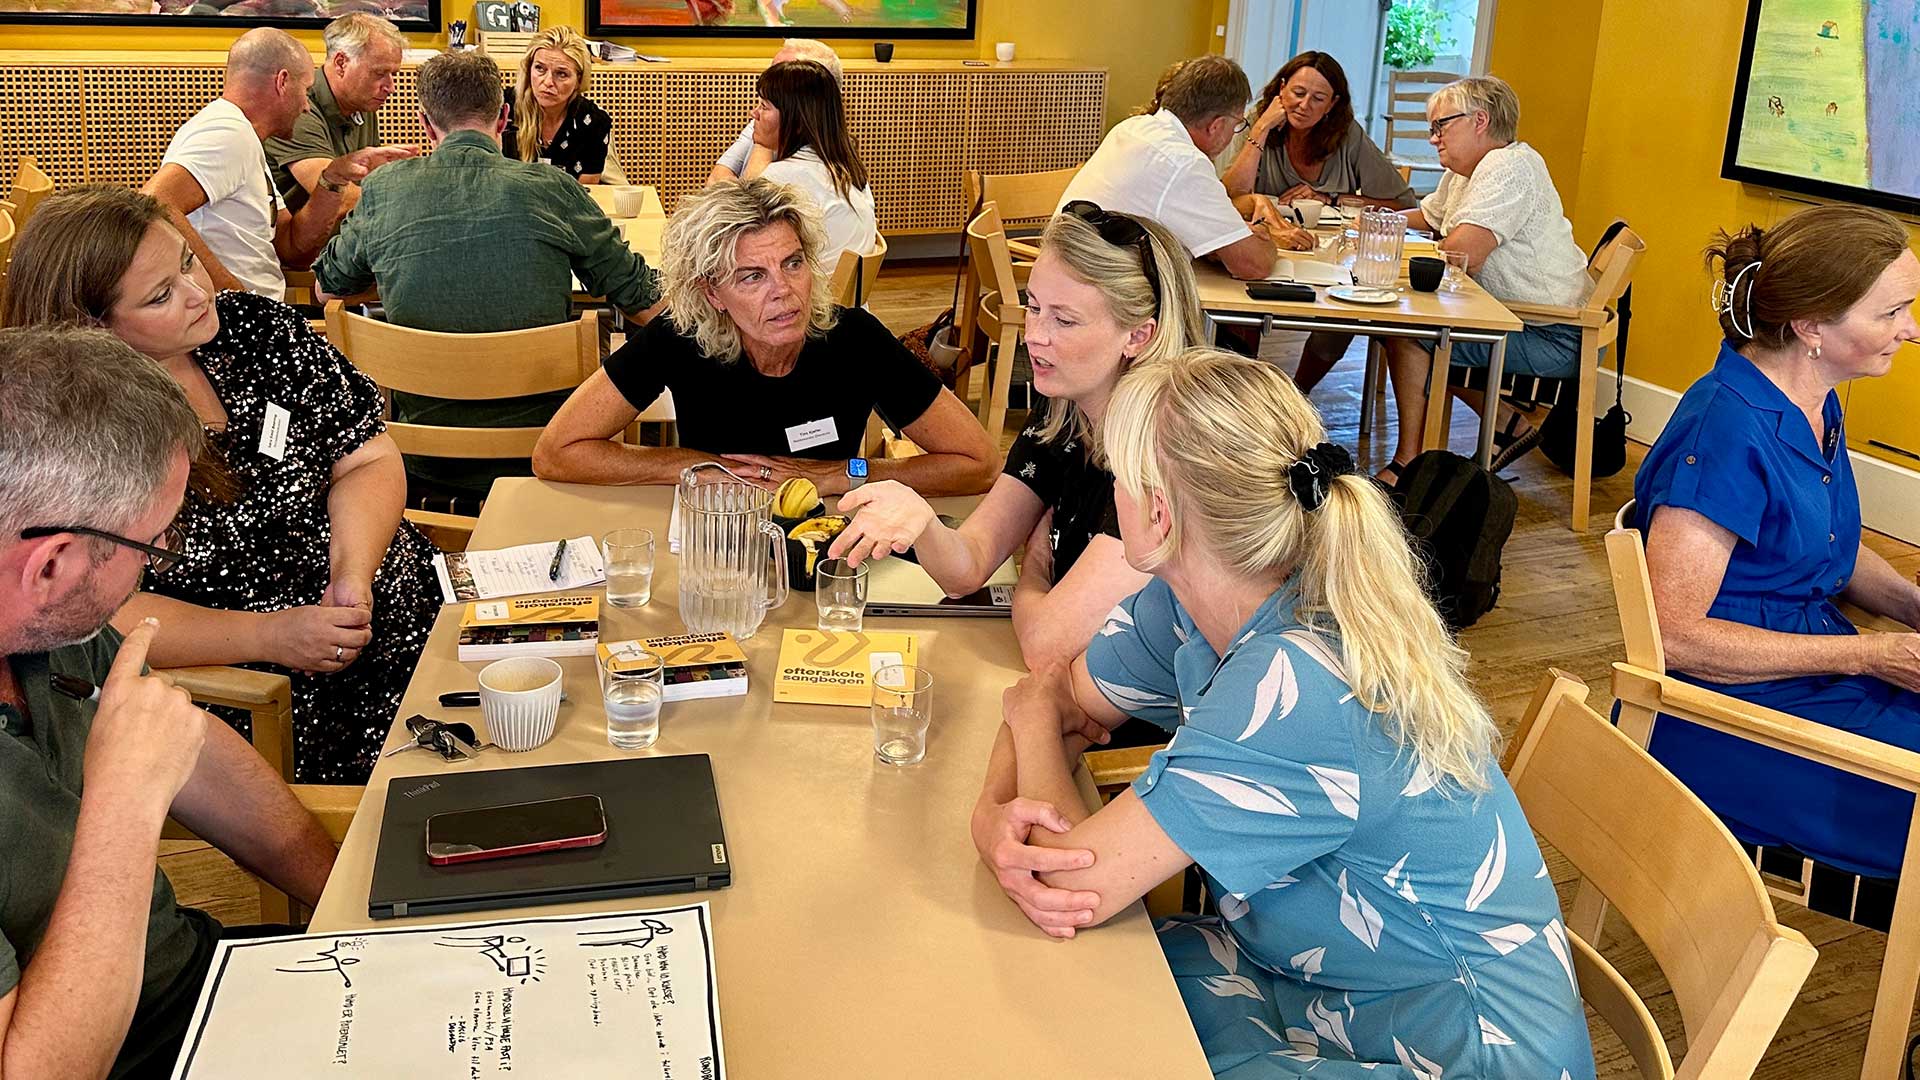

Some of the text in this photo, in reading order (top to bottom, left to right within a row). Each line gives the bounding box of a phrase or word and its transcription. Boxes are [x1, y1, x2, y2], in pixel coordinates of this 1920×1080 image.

[514, 596, 593, 604] sangbogen
[514, 600, 593, 609] efterskole
[646, 631, 725, 644] sangbogen
[648, 635, 727, 648] efterskole
[783, 667, 865, 679] efterskole
[782, 674, 865, 685] sangbogen
[403, 780, 441, 800] ThinkPad
